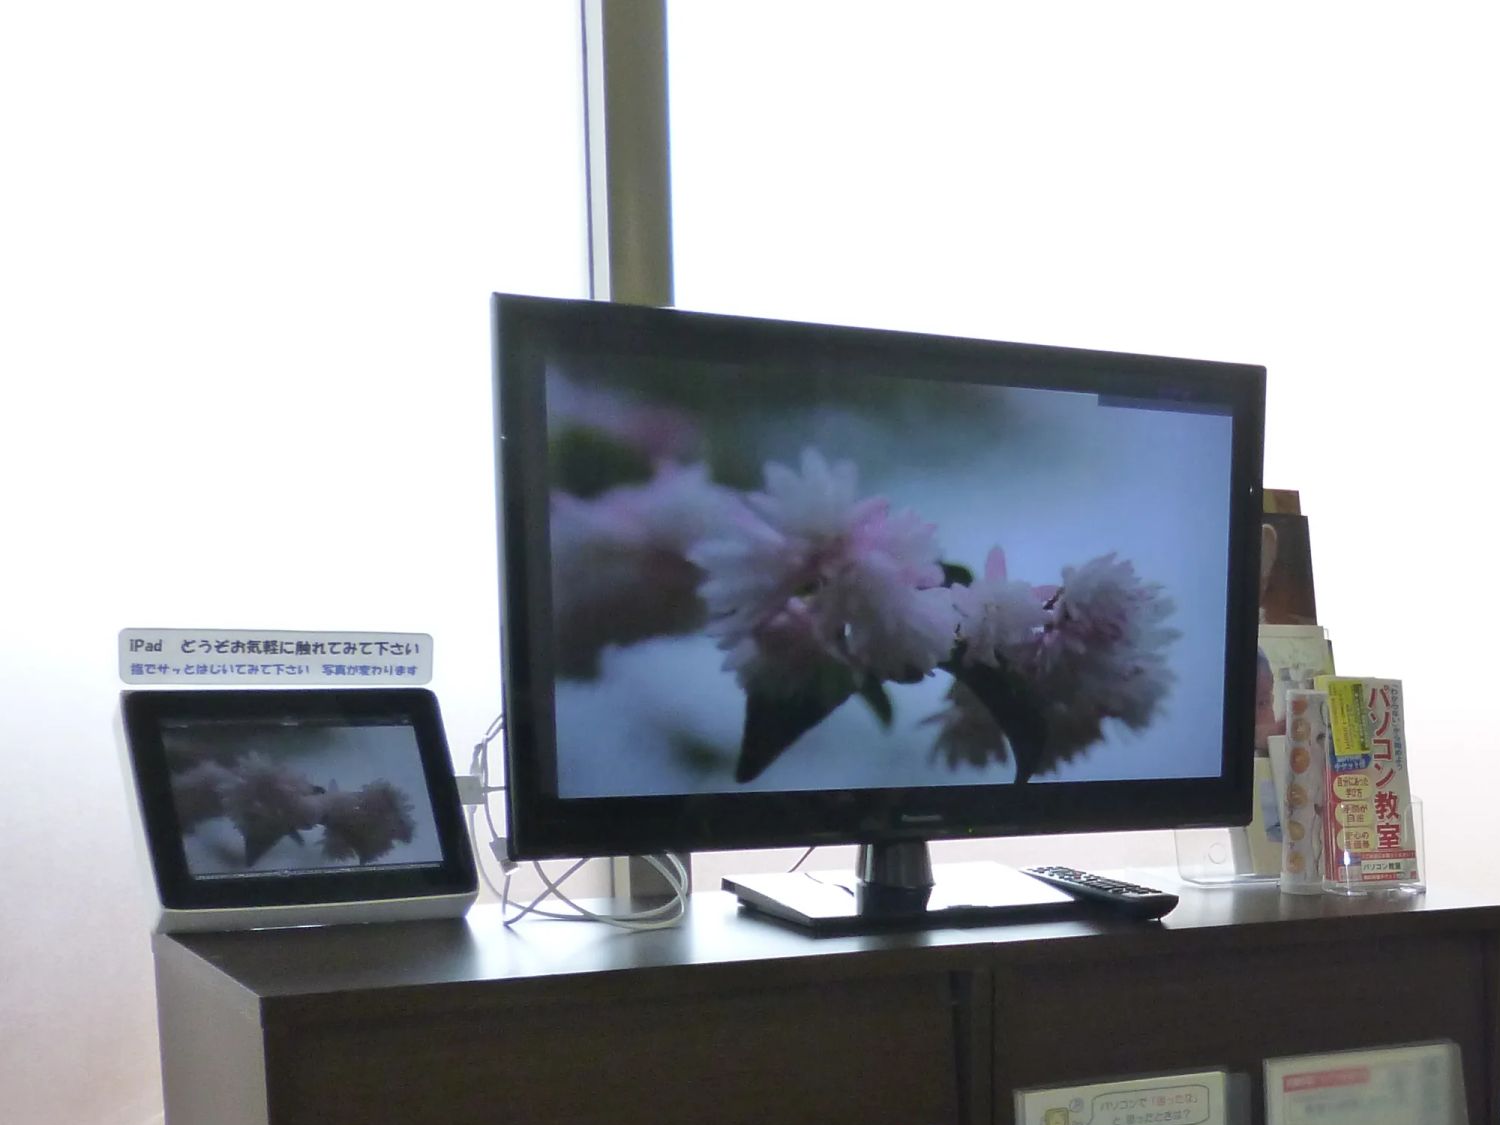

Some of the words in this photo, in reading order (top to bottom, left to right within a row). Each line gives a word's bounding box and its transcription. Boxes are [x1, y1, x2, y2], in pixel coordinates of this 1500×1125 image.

[130, 638, 163, 653] iPad
[181, 638, 420, 657] どうぞお気軽に触れてみて下さい
[1367, 683, 1401, 850] パソコン教室
